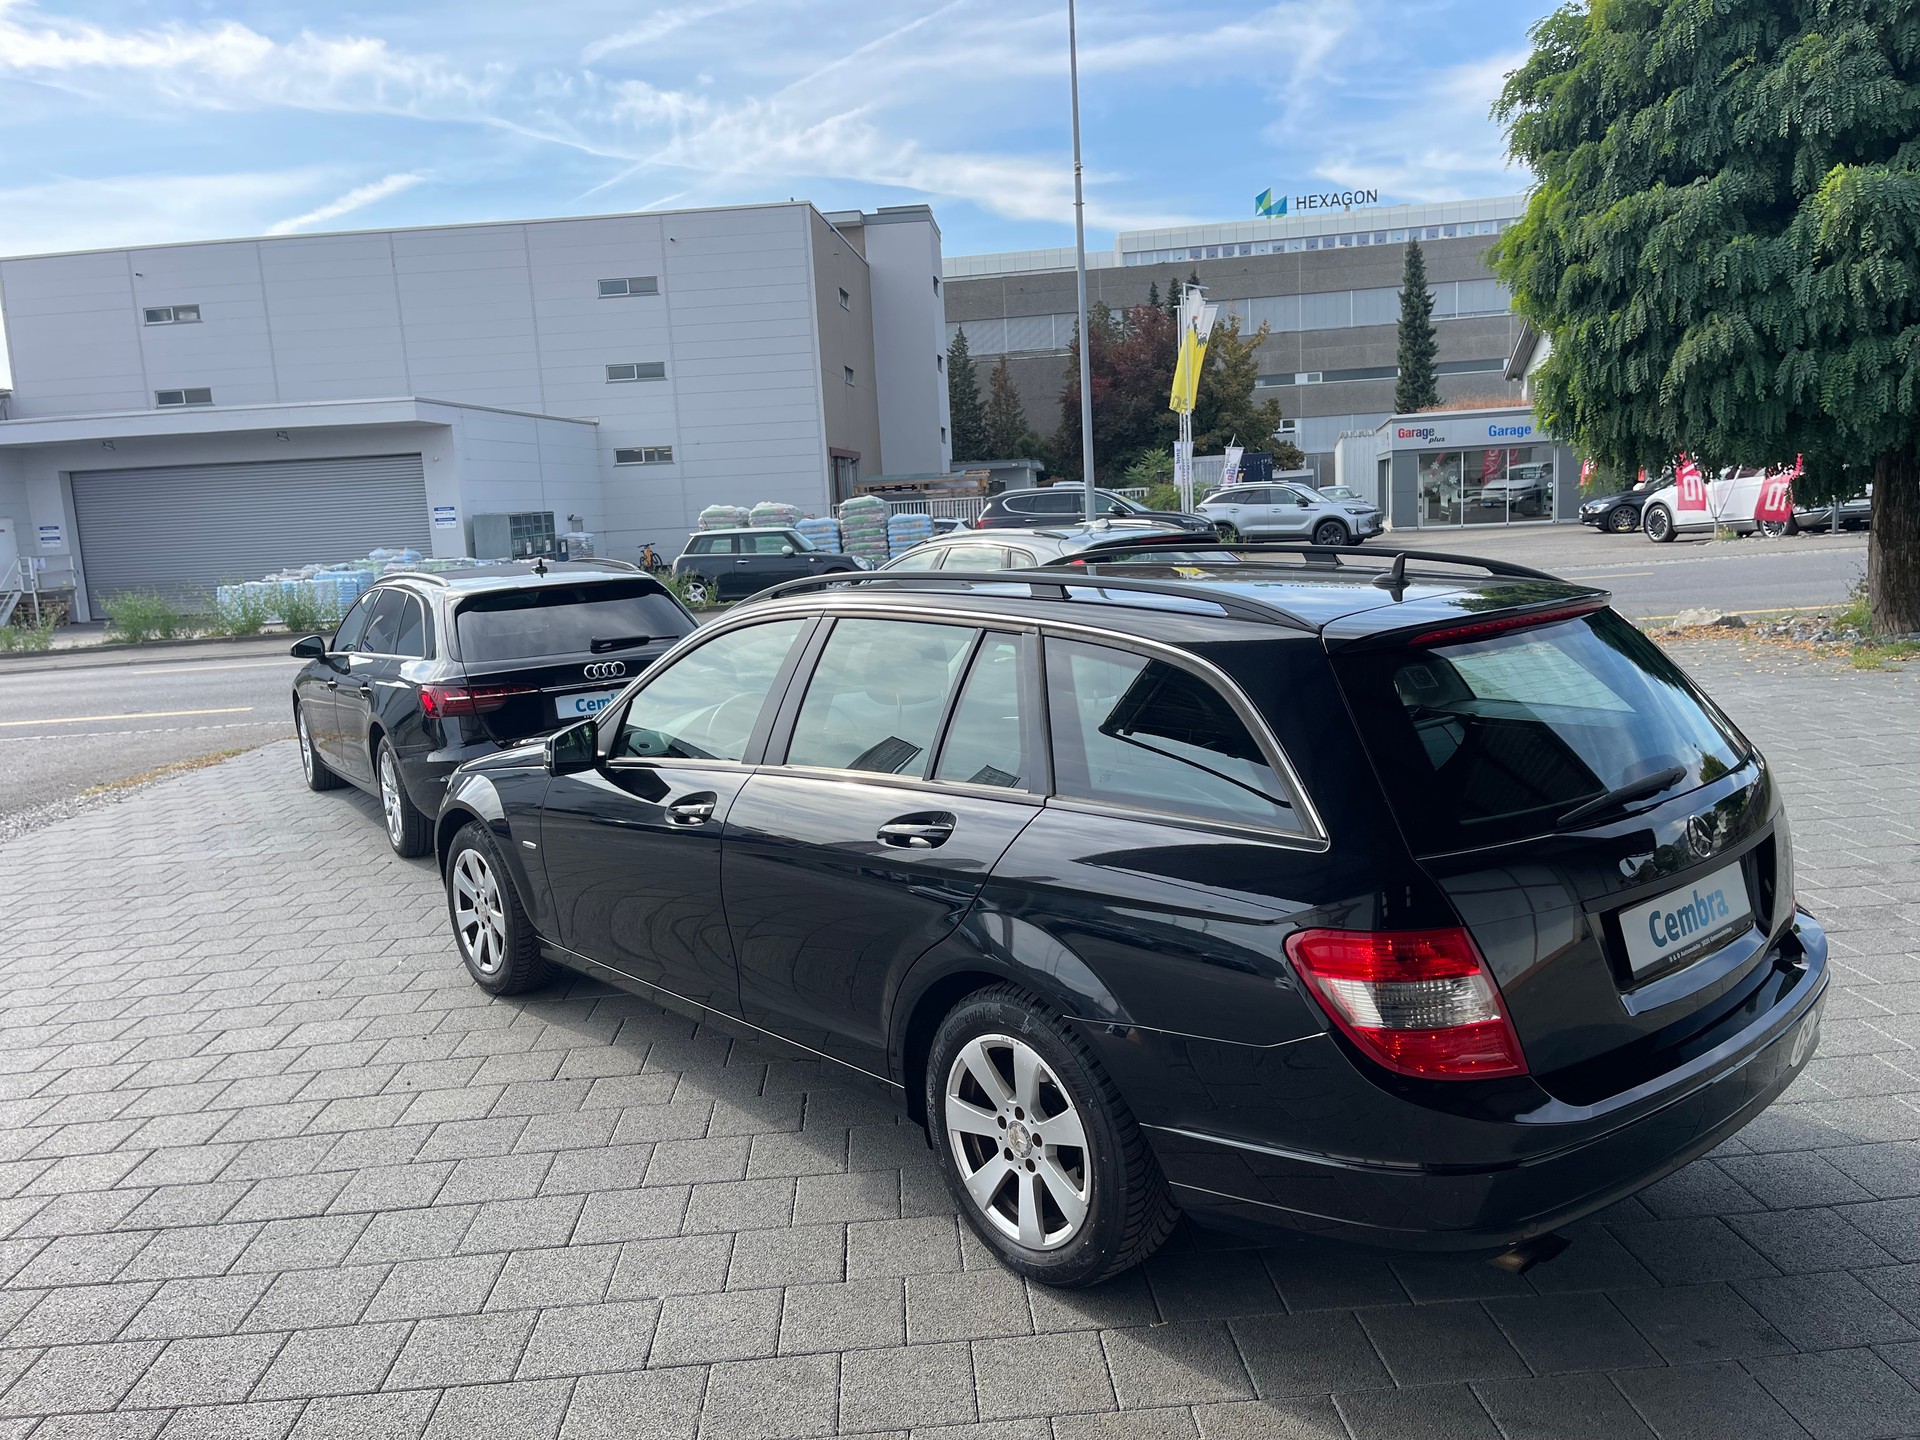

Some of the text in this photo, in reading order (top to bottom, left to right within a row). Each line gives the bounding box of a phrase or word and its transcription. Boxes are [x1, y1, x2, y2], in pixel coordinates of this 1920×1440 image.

[1296, 189, 1377, 210] HEXAGON
[1398, 428, 1435, 440] Garage
[1489, 425, 1531, 438] Garage
[1428, 436, 1446, 444] plus
[575, 693, 615, 713] Cem
[1649, 889, 1729, 948] Cembra
